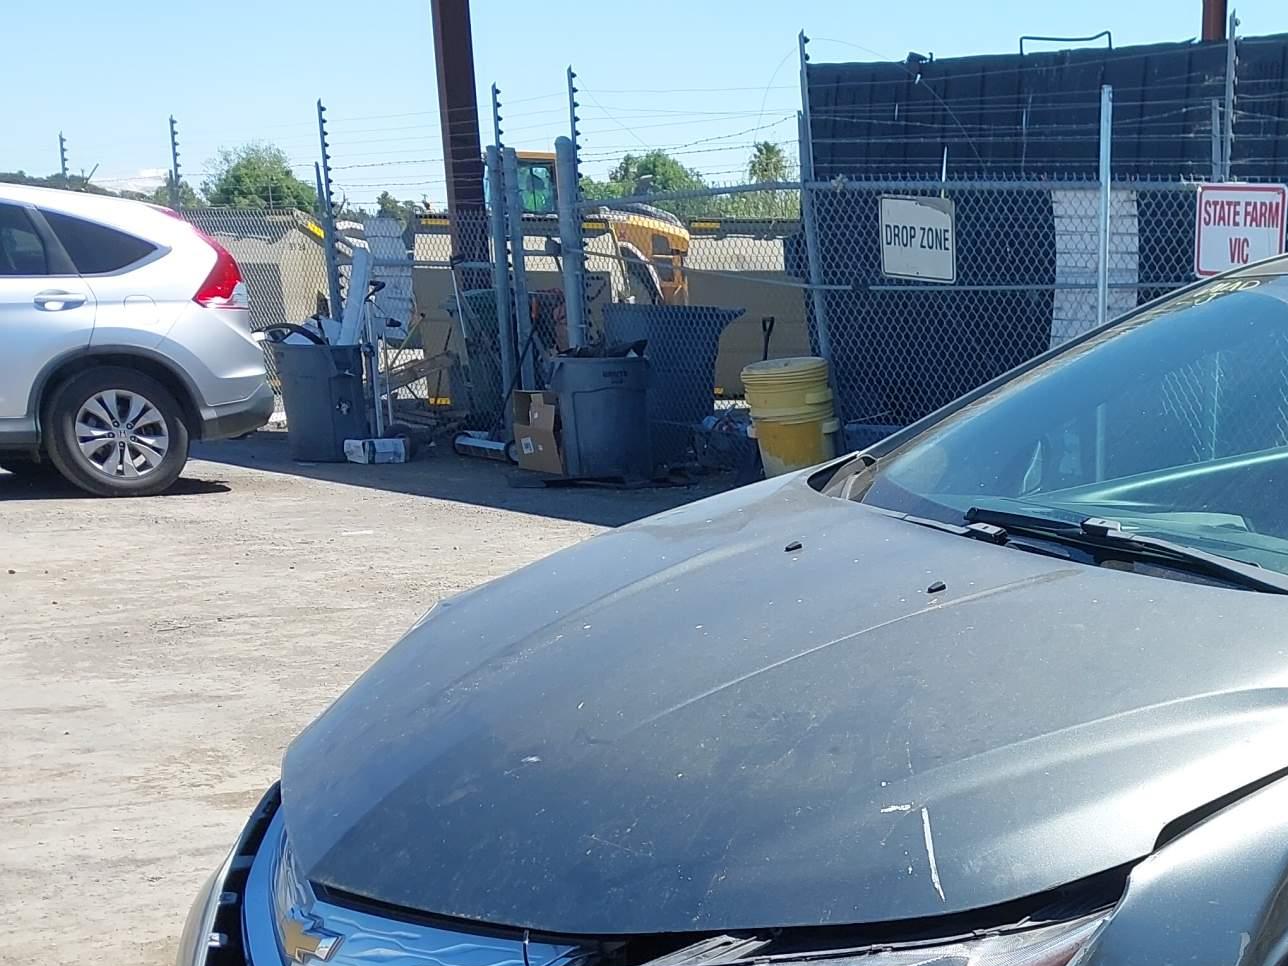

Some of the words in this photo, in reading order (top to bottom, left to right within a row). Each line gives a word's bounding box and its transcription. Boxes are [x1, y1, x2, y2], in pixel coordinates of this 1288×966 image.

[1203, 199, 1241, 227] STATE
[1243, 201, 1280, 228] FARM
[885, 223, 917, 248] DROP
[919, 226, 950, 251] ZONE
[1229, 237, 1250, 264] VIC
